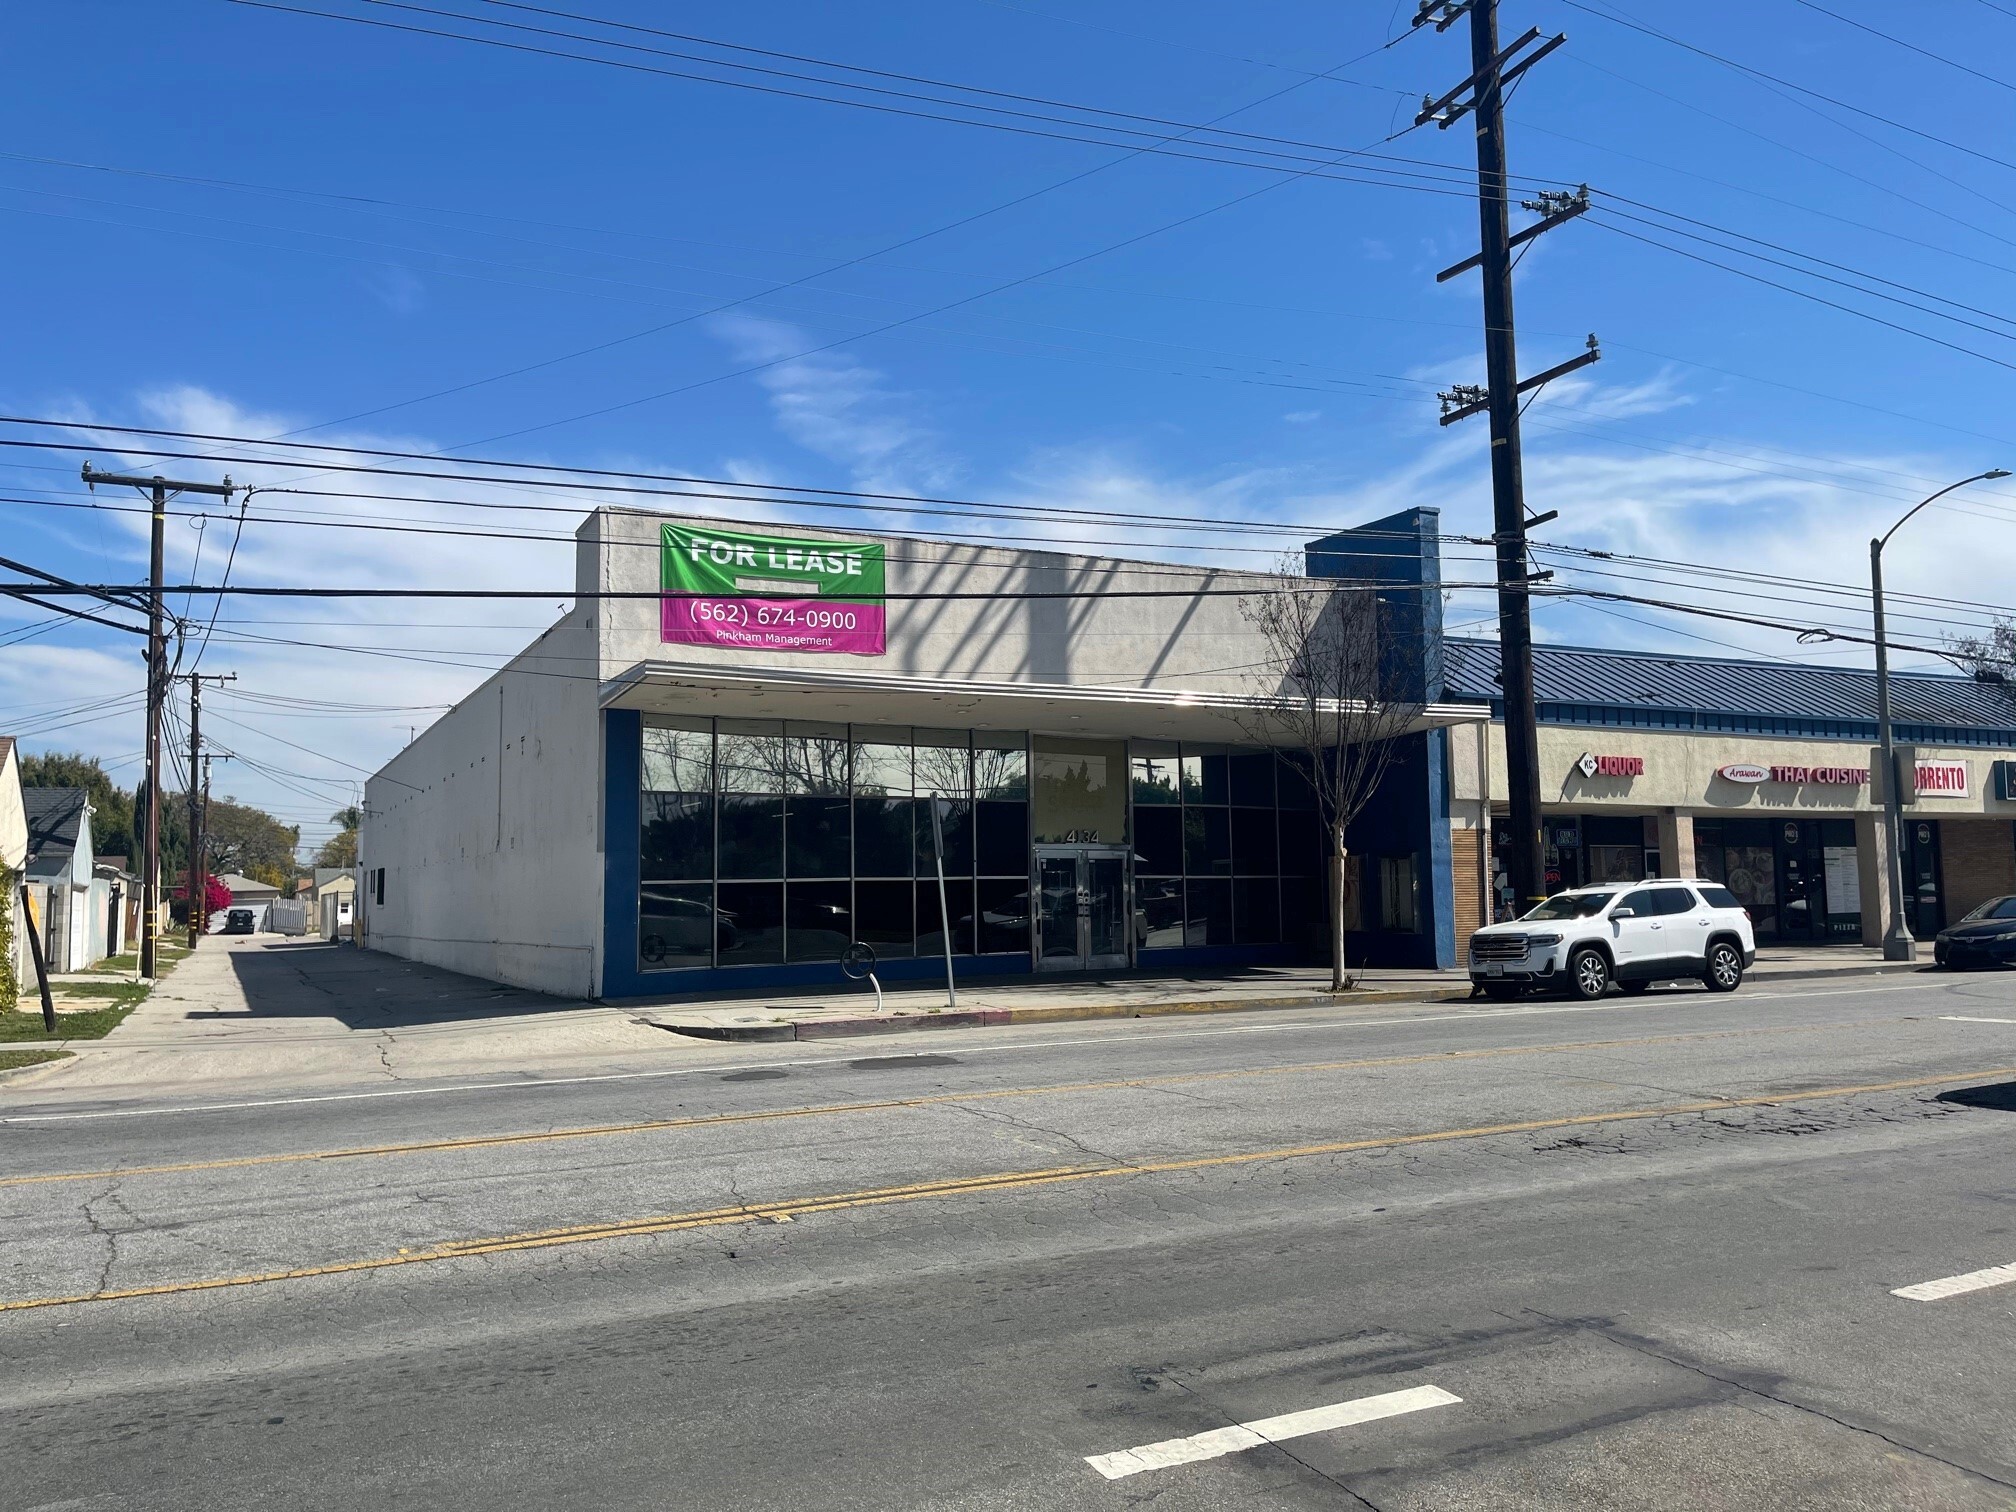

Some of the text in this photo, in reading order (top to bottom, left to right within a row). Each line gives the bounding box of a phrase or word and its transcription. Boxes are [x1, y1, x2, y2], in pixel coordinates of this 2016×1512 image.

[690, 538, 862, 576] FOR LEASE
[690, 601, 856, 630] (562) 674-0900
[716, 629, 832, 646] Pinkham Management
[1584, 756, 1644, 776] KC LIQUOR
[1729, 766, 1870, 784] Arawan THAI CUISINE
[1066, 829, 1099, 843] 434
